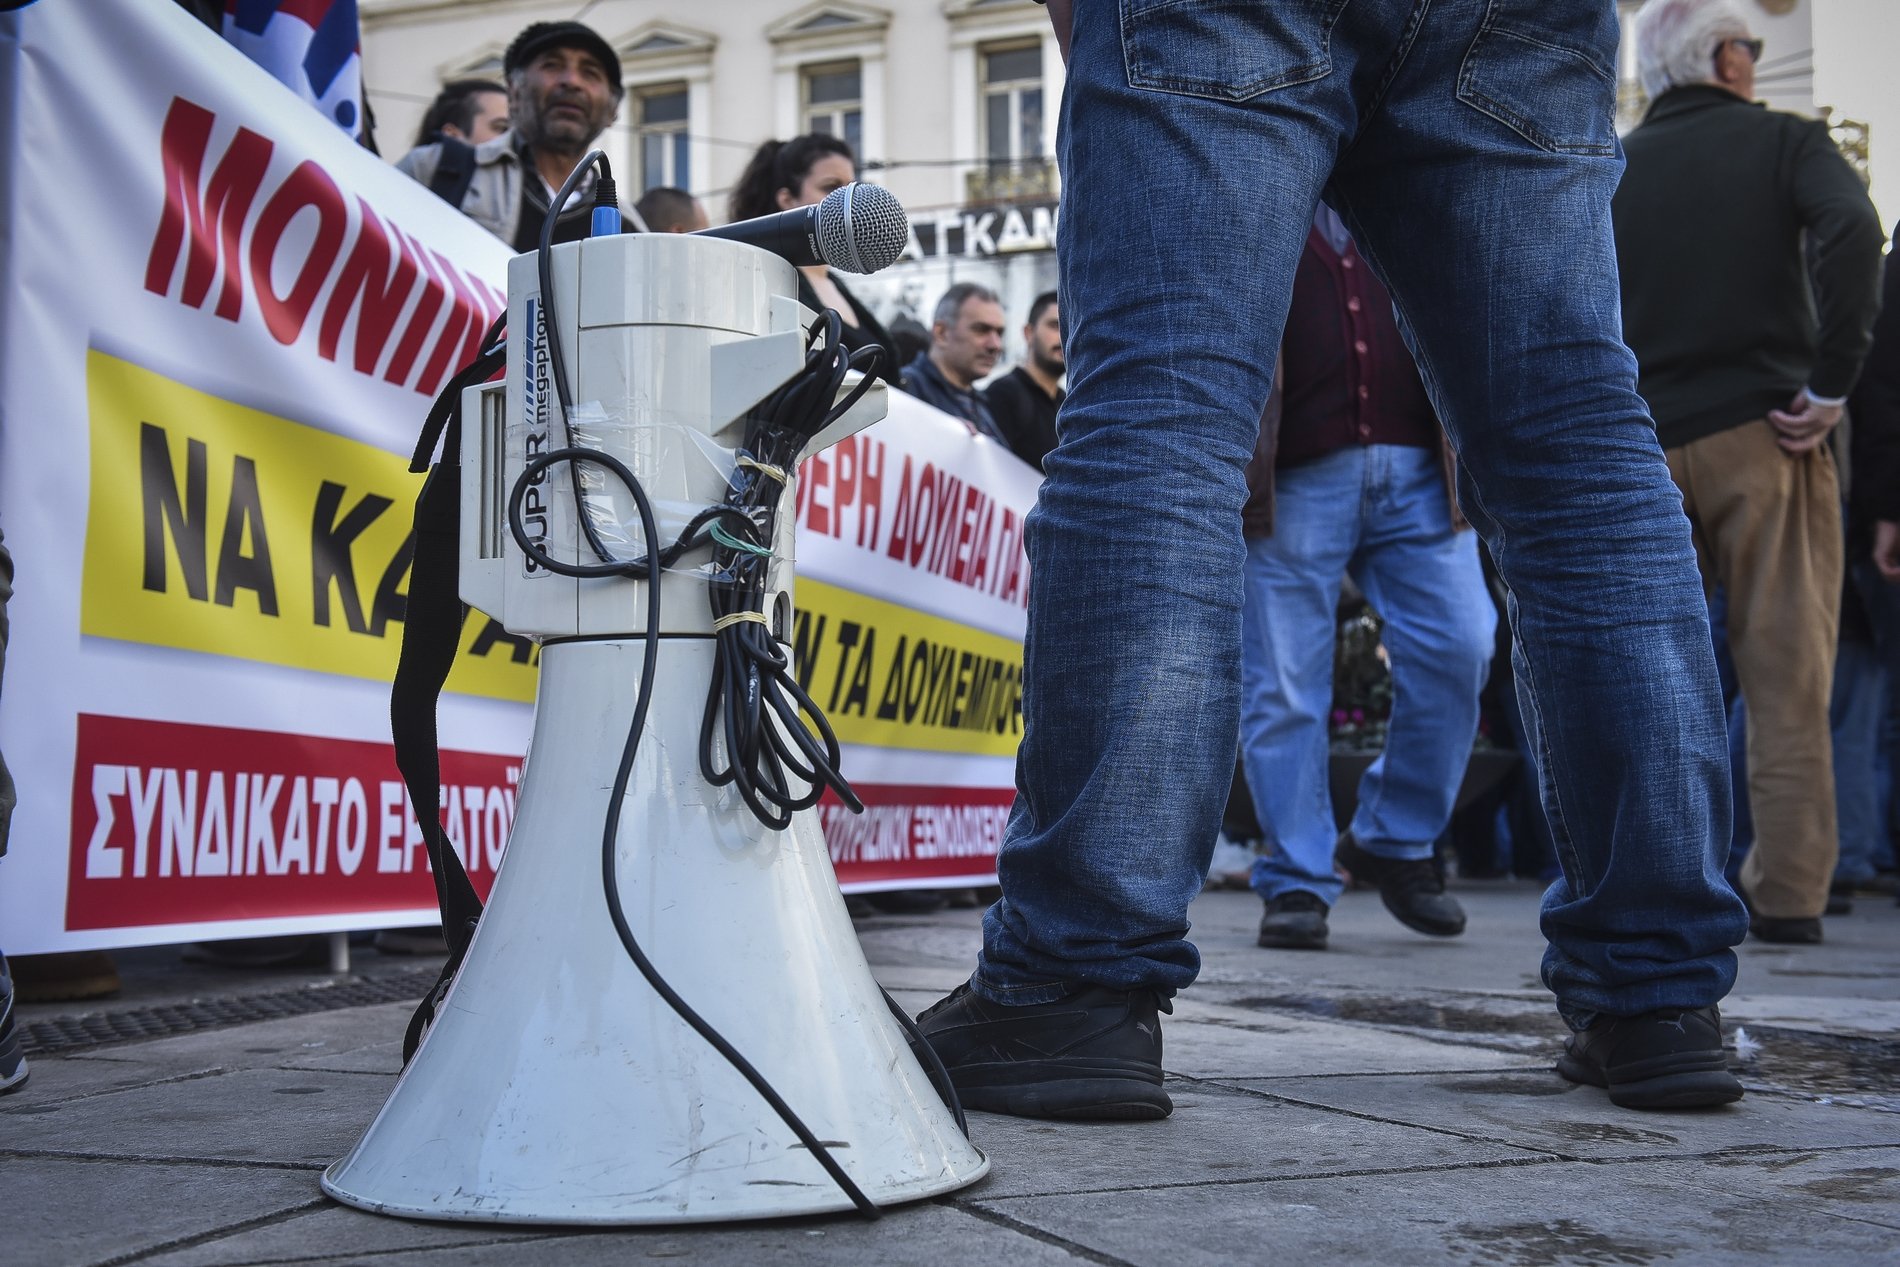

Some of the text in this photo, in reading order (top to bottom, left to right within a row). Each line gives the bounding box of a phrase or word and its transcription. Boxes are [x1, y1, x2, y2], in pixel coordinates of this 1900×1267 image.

[144, 96, 508, 397] ΜΟΝΙΜ
[141, 421, 279, 617] ΝΑ
[827, 620, 876, 717] ΤΑ
[86, 763, 367, 878] ΣΥΝΔΙΚΑΤΟ
